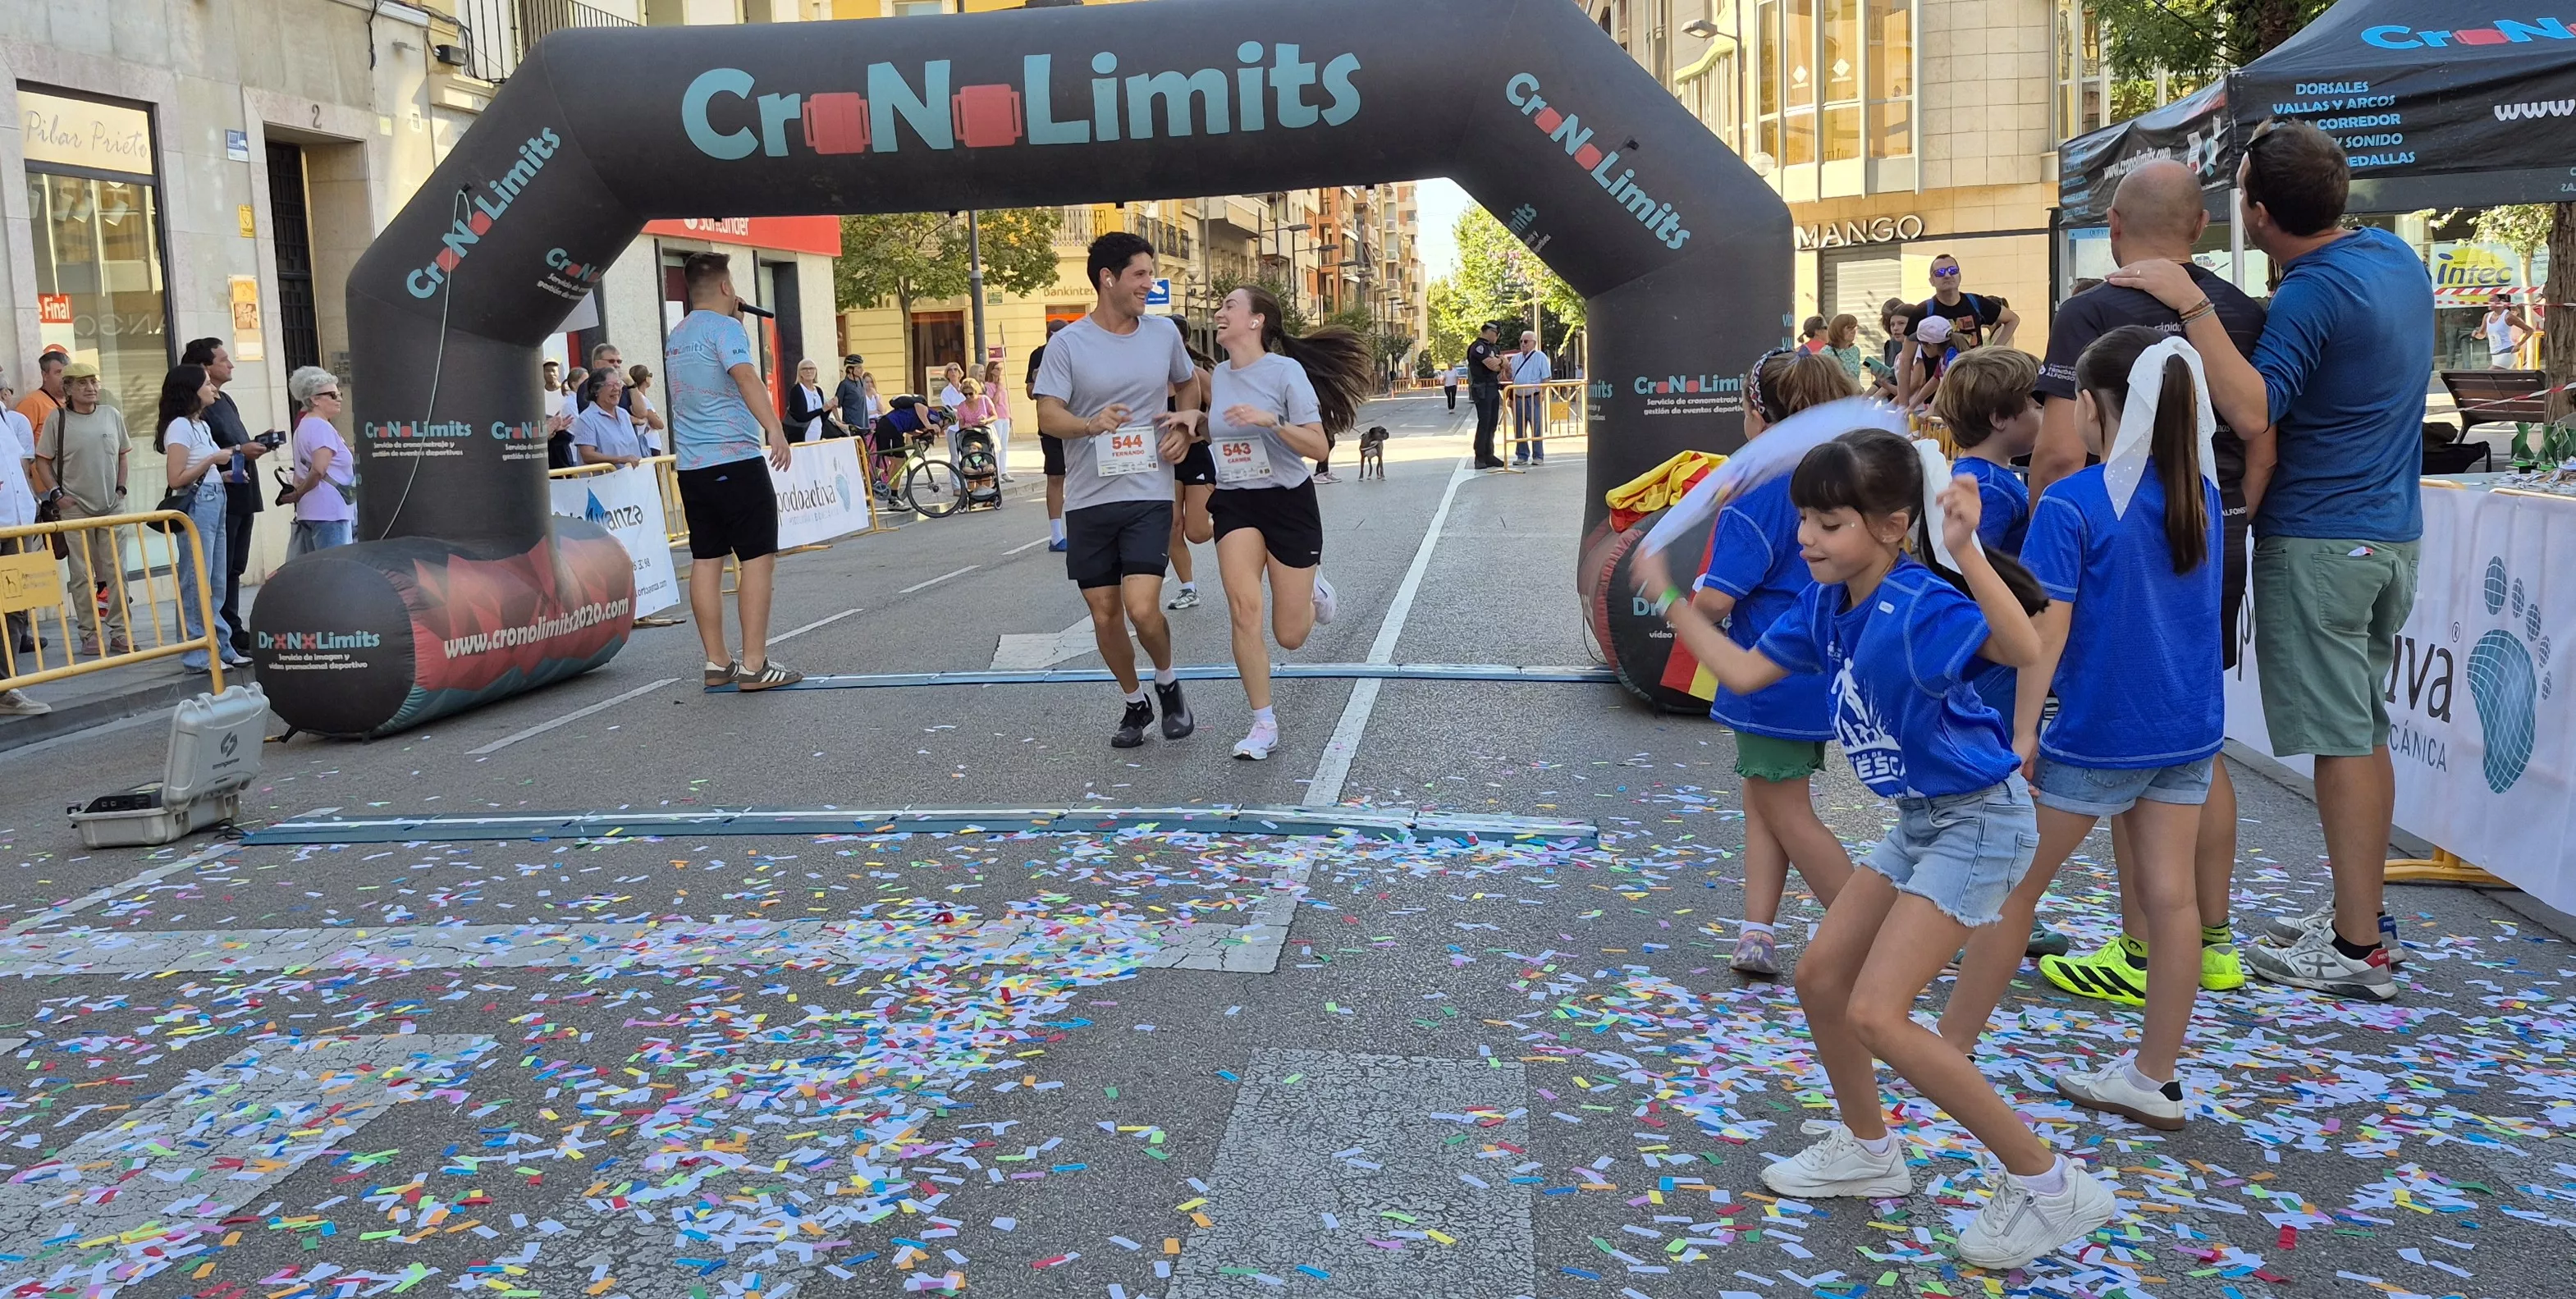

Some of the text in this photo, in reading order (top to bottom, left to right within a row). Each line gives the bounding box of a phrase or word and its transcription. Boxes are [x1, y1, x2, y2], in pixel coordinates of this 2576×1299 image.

[2295, 81, 2369, 95] DORSALES
[2272, 94, 2396, 115] VALLAS Y ARCOS
[312, 103, 322, 129] 2
[2317, 113, 2401, 130] CORREDOR
[25, 110, 148, 158] Pilar Prieto
[2345, 132, 2404, 149] SONIDO
[2345, 151, 2416, 167] EDALLAS
[1794, 214, 1923, 249] MANGO
[44, 295, 71, 320] Final
[1687, 396, 1737, 404] cronometraje
[1644, 406, 1670, 415] gestión
[1671, 406, 1681, 414] de
[1714, 405, 1745, 413] deportiv
[1112, 434, 1142, 450] 544
[1223, 442, 1251, 456] 543
[776, 479, 836, 527] podoactiva
[444, 597, 629, 660] www.cronolimits2020.com
[286, 662, 328, 670] promocional
[329, 661, 368, 670] deportivo
[314, 653, 343, 661] imagen
[2389, 719, 2447, 773] CÁNICA
